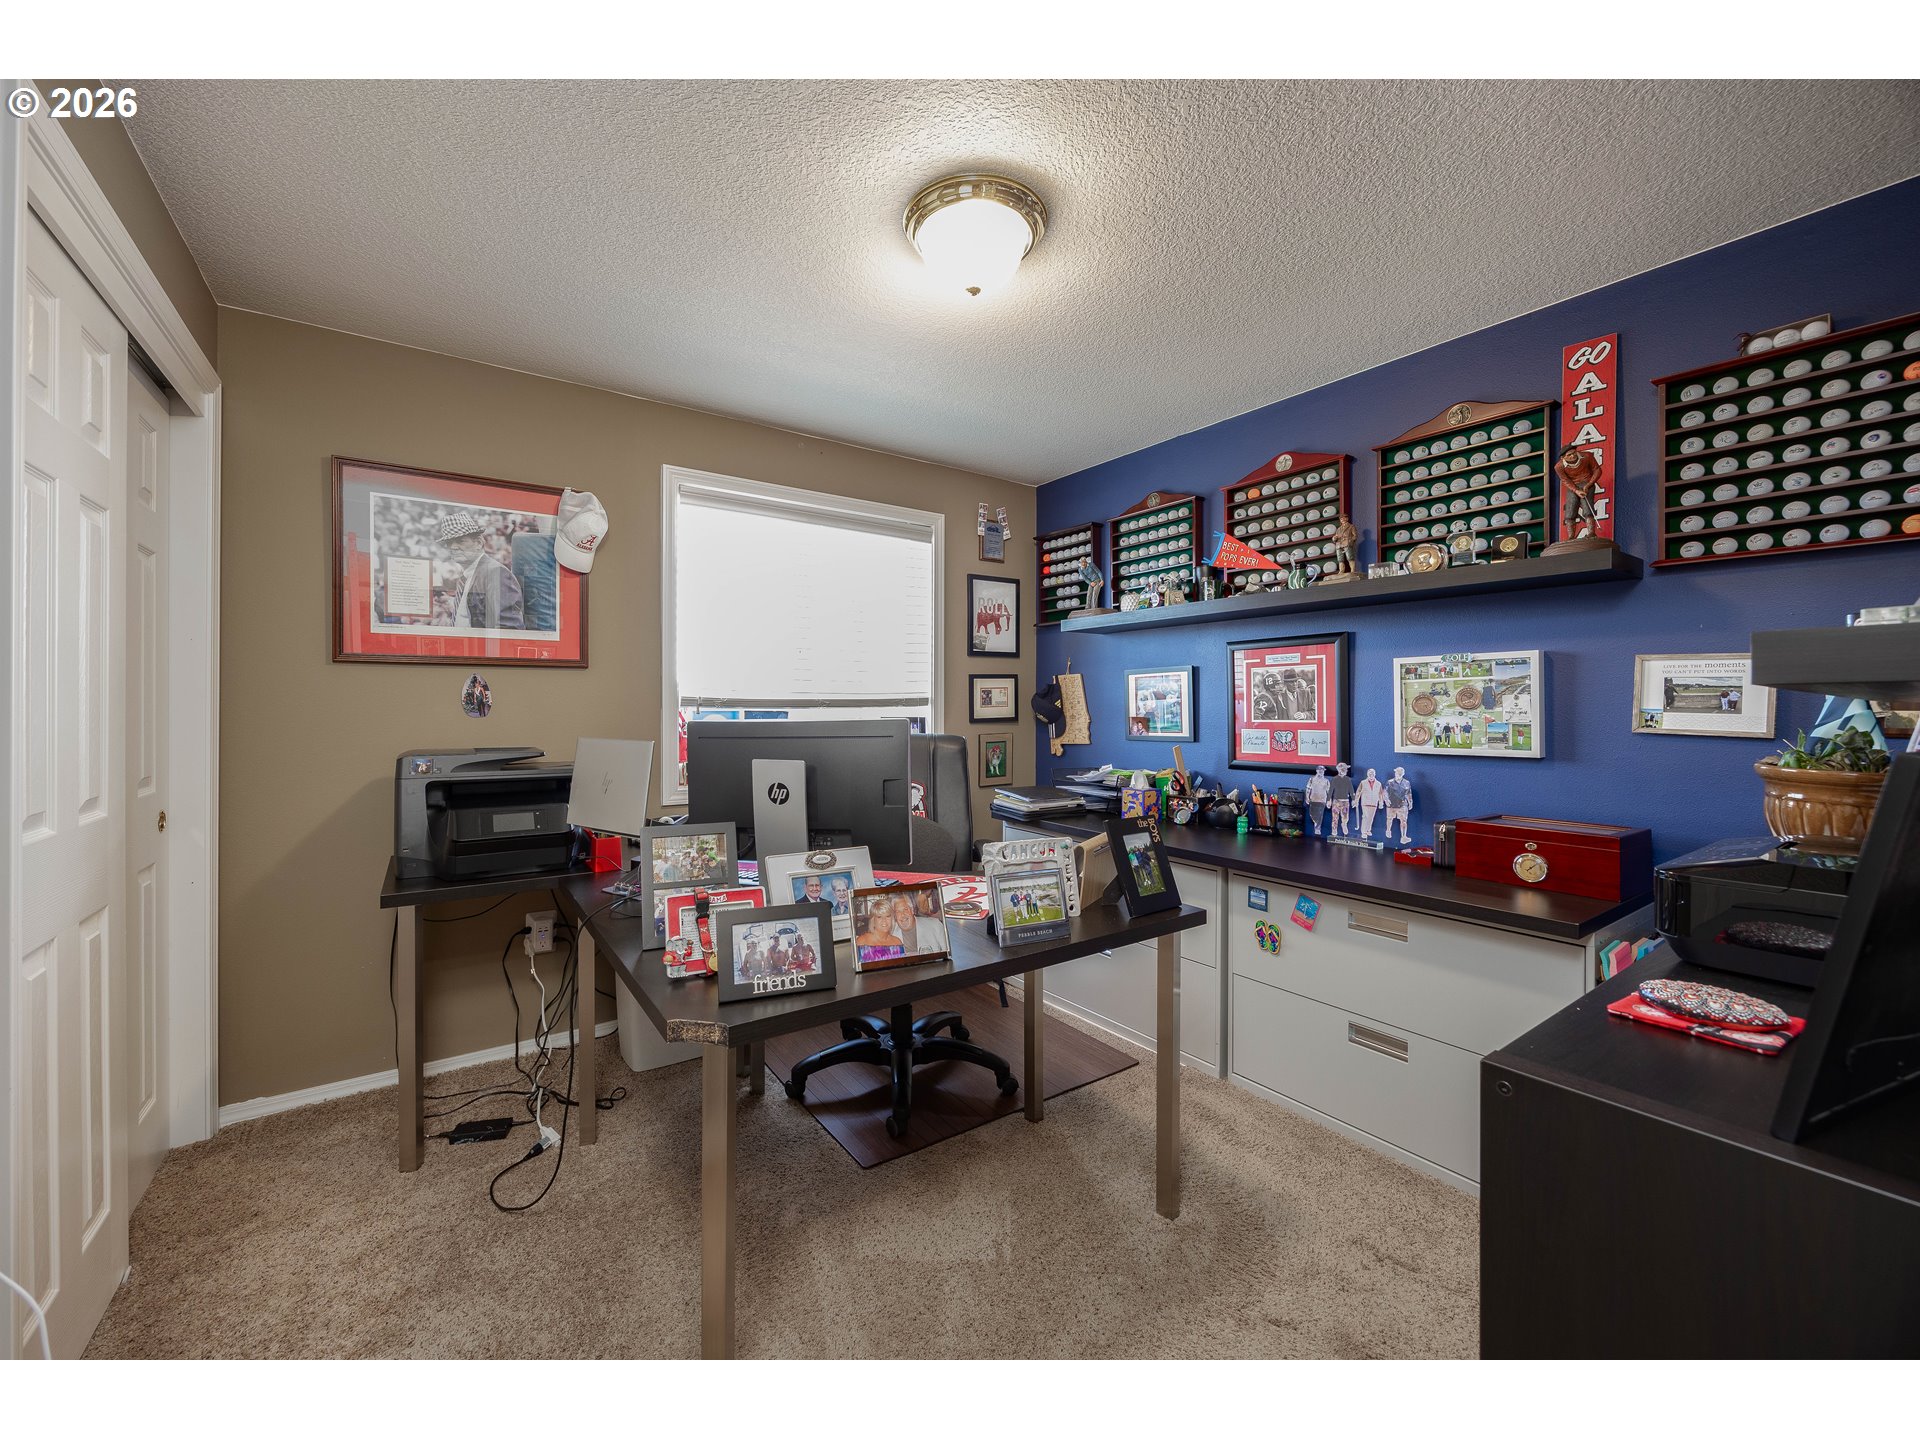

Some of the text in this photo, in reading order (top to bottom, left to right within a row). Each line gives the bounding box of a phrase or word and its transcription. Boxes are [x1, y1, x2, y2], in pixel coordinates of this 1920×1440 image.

[1568, 341, 1611, 370] GO
[1222, 541, 1240, 552] BEST
[1221, 551, 1259, 567] POPS EVER!
[978, 597, 1007, 615] ROLL
[1265, 677, 1274, 686] 12
[1259, 700, 1268, 711] 12
[770, 782, 788, 805] hp
[1137, 817, 1161, 843] the BOYS
[999, 842, 1057, 861] CANCUN
[1063, 853, 1075, 911] MEXICO
[752, 970, 807, 994] friends
